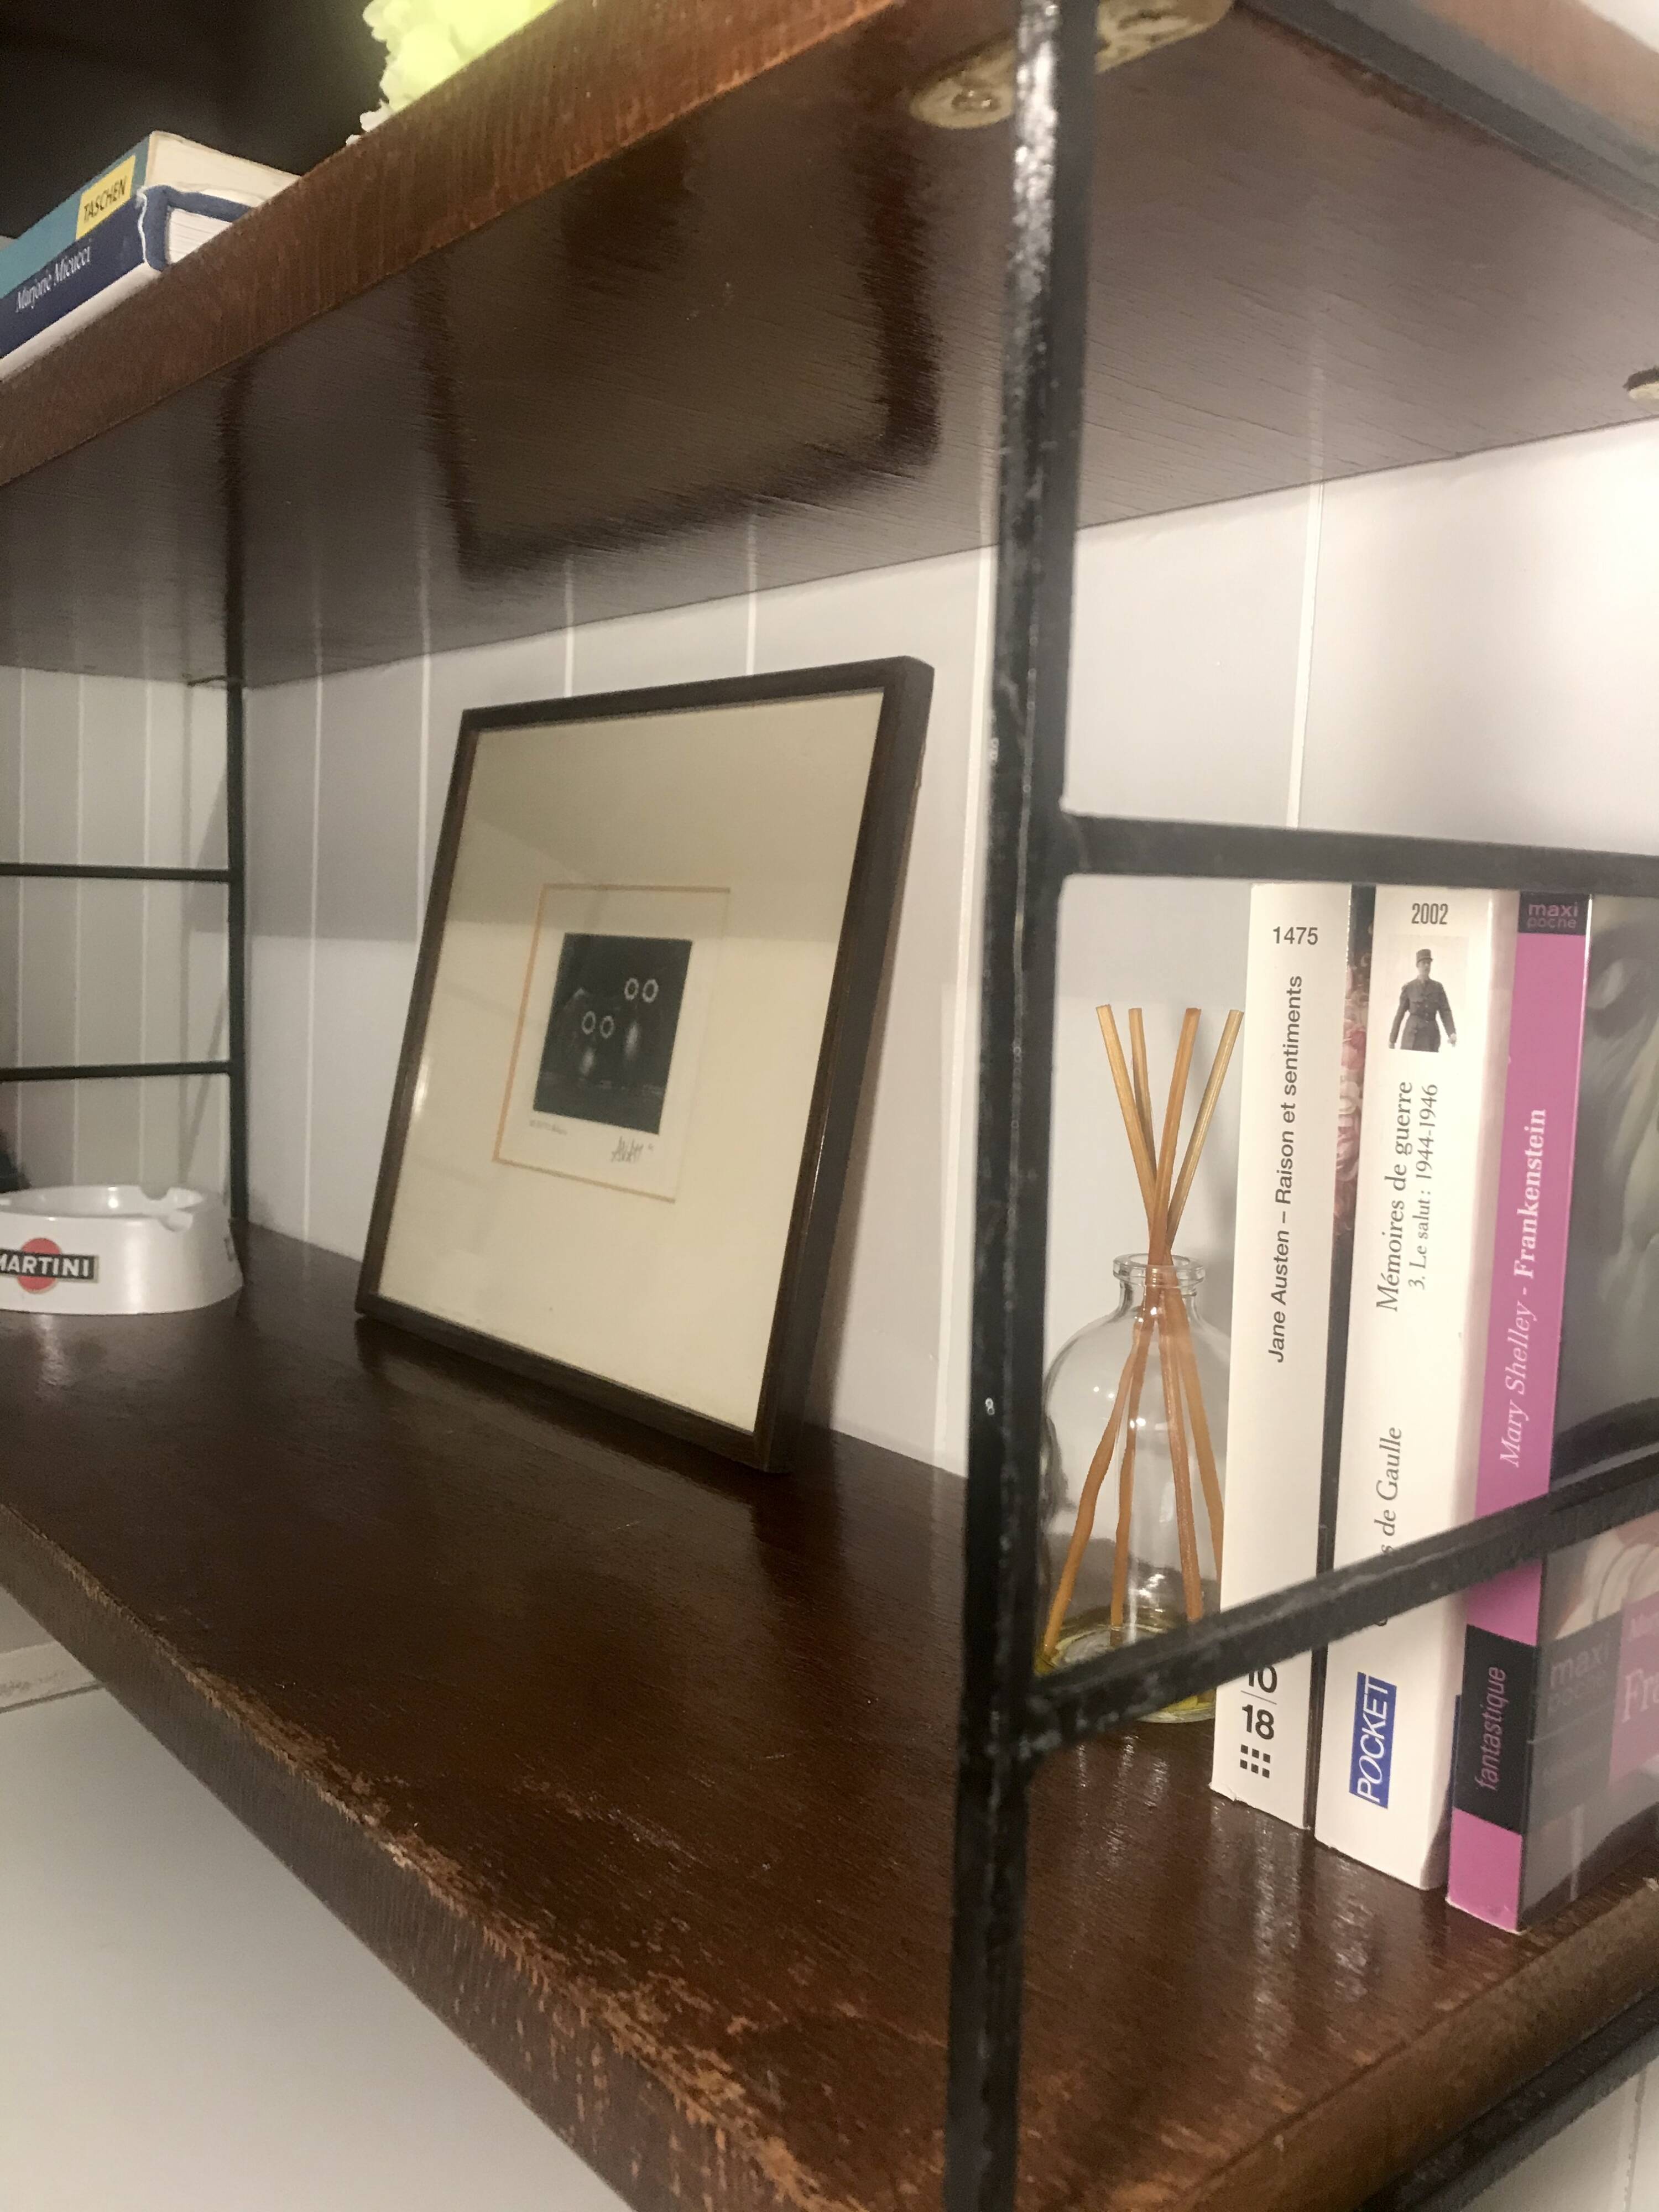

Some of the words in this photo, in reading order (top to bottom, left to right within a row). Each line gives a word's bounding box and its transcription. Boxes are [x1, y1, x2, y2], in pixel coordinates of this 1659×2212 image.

[84, 175, 127, 223] TASCHEN
[1273, 926, 1318, 945] 1475
[1411, 902, 1448, 925] 2002
[1528, 901, 1579, 917] maxi
[1282, 975, 1302, 1095] sentiments
[1281, 1102, 1296, 1123] et
[1395, 1081, 1413, 1155] guerre
[1416, 1084, 1438, 1179] 1944-1946
[1275, 1130, 1295, 1204] Raison
[1384, 1164, 1407, 1191] de
[1514, 1108, 1547, 1279] Frankenstein
[1271, 1229, 1290, 1306] Austen
[1375, 1199, 1405, 1312] Mémoires
[1408, 1275, 1426, 1290] 3.
[1409, 1245, 1427, 1270] Le
[1268, 1310, 1286, 1363] Jane
[1505, 1300, 1538, 1395] Shelley
[1375, 1427, 1402, 1501] Gaulle
[1500, 1399, 1530, 1468] Mary
[1374, 1509, 1396, 1537] de
[1242, 1704, 1275, 1740] 18
[1357, 1674, 1389, 1803] POCKET
[1474, 1666, 1510, 1791] fantastique
